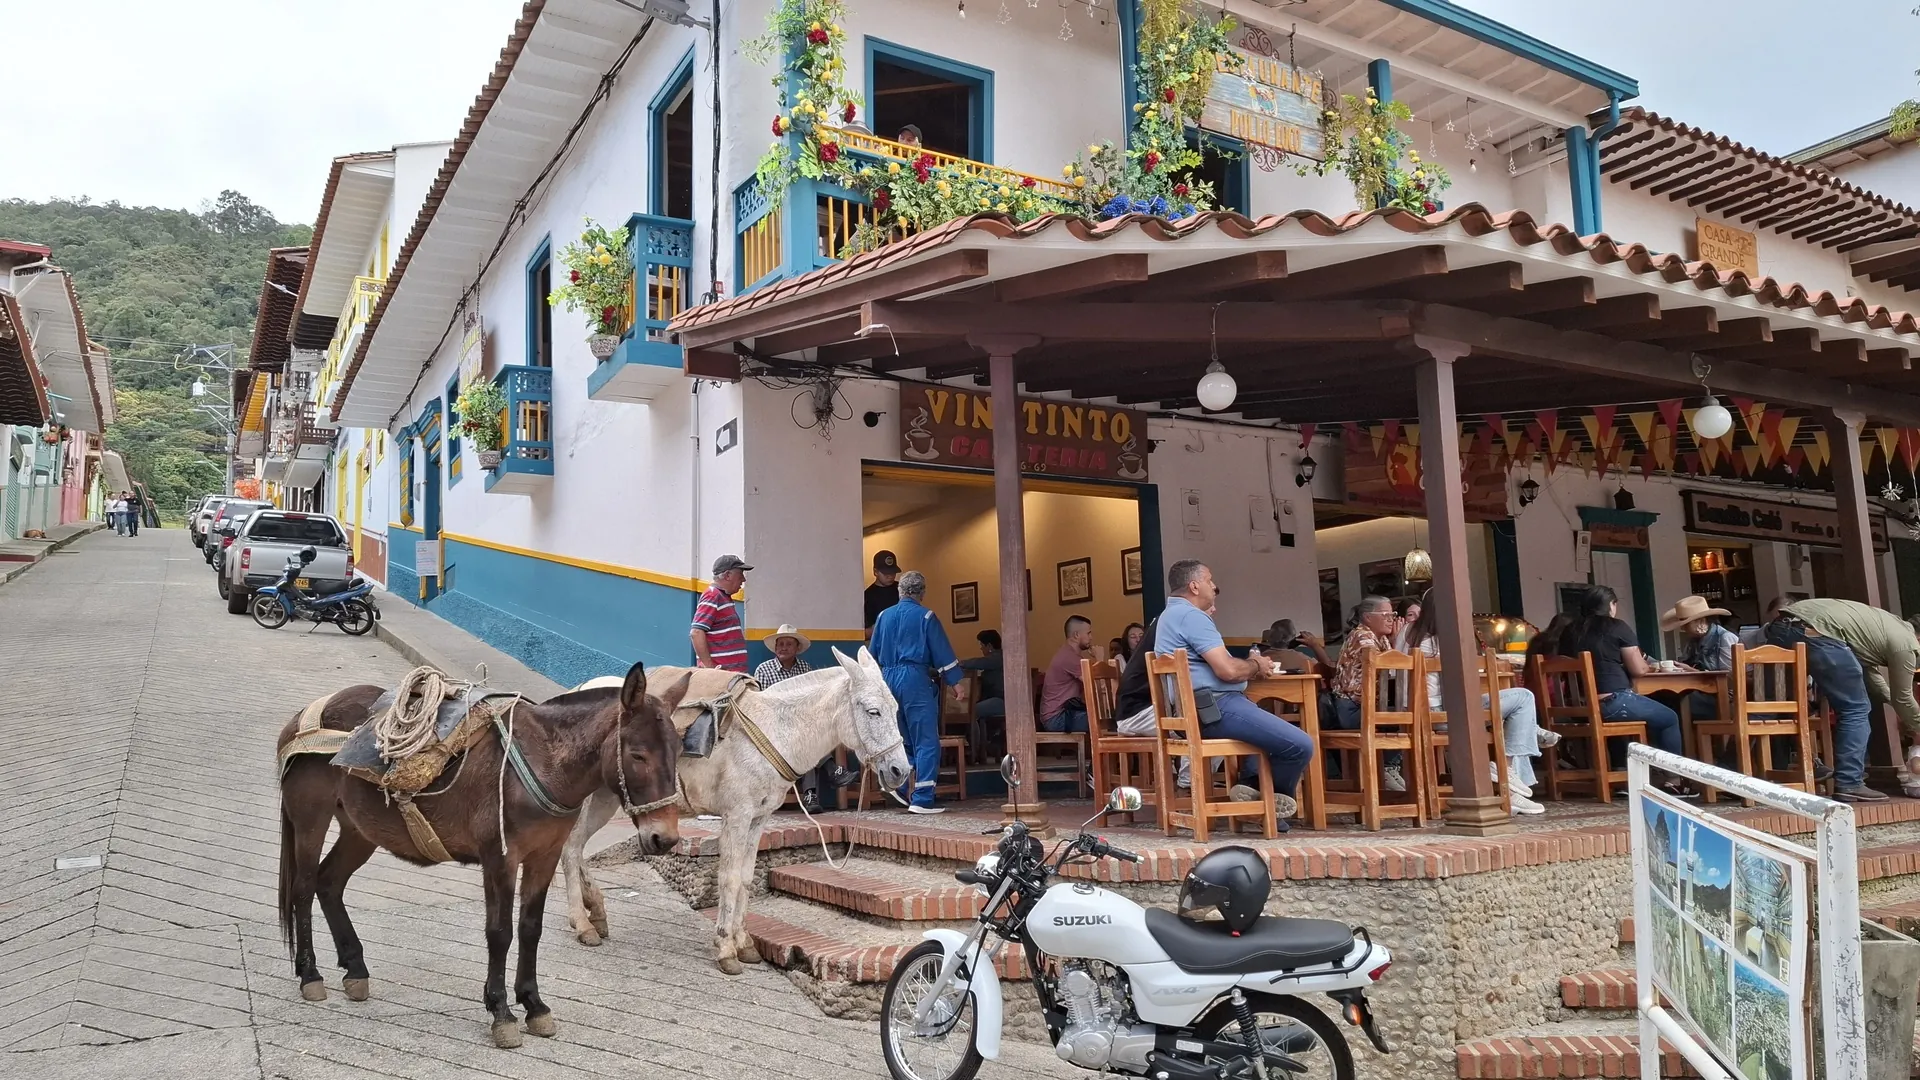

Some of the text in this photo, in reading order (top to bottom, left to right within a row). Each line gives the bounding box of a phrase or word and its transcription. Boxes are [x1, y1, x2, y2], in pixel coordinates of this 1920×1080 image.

[1215, 52, 1321, 104] ESTAURANTE
[1704, 225, 1733, 245] CASA
[1700, 242, 1746, 268] GRANDE
[925, 389, 993, 429] VIN
[951, 436, 1107, 469] CATERIA
[1053, 914, 1112, 927] SUZUKI
